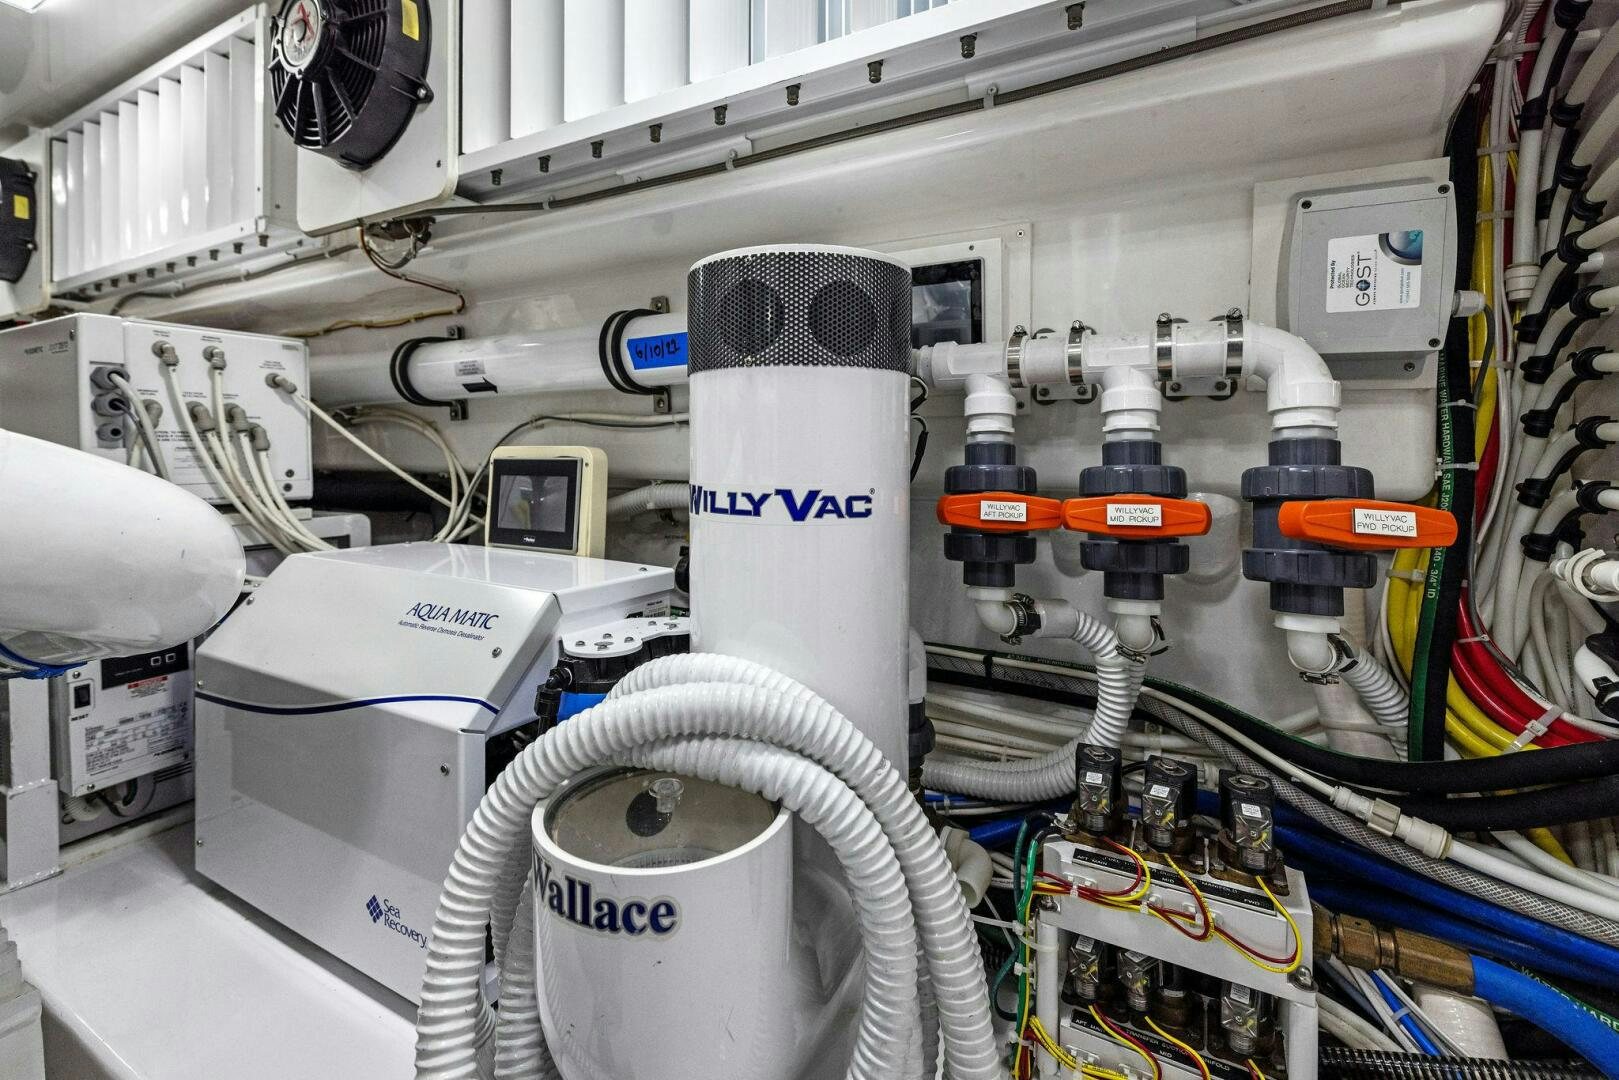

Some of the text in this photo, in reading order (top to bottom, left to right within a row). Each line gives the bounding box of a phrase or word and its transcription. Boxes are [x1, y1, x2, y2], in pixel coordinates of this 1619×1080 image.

[1355, 254, 1372, 306] GOST
[1442, 473, 1451, 490] SAE
[987, 503, 1021, 511] WILLYVAC
[1114, 506, 1154, 515] WILLYVAC
[984, 510, 1024, 520] AFT PICKUP
[1110, 515, 1159, 524] MID PICKUP
[1363, 513, 1408, 524] WILLYVAC
[1357, 522, 1415, 533] FWD PICKUP
[406, 602, 499, 630] AQUA MATIC
[398, 620, 485, 641] Automatic Reverse Osmosis Desalinator
[533, 852, 677, 936] Wallace
[383, 898, 427, 948] Sea Recovery
[1158, 1049, 1173, 1059] MID
